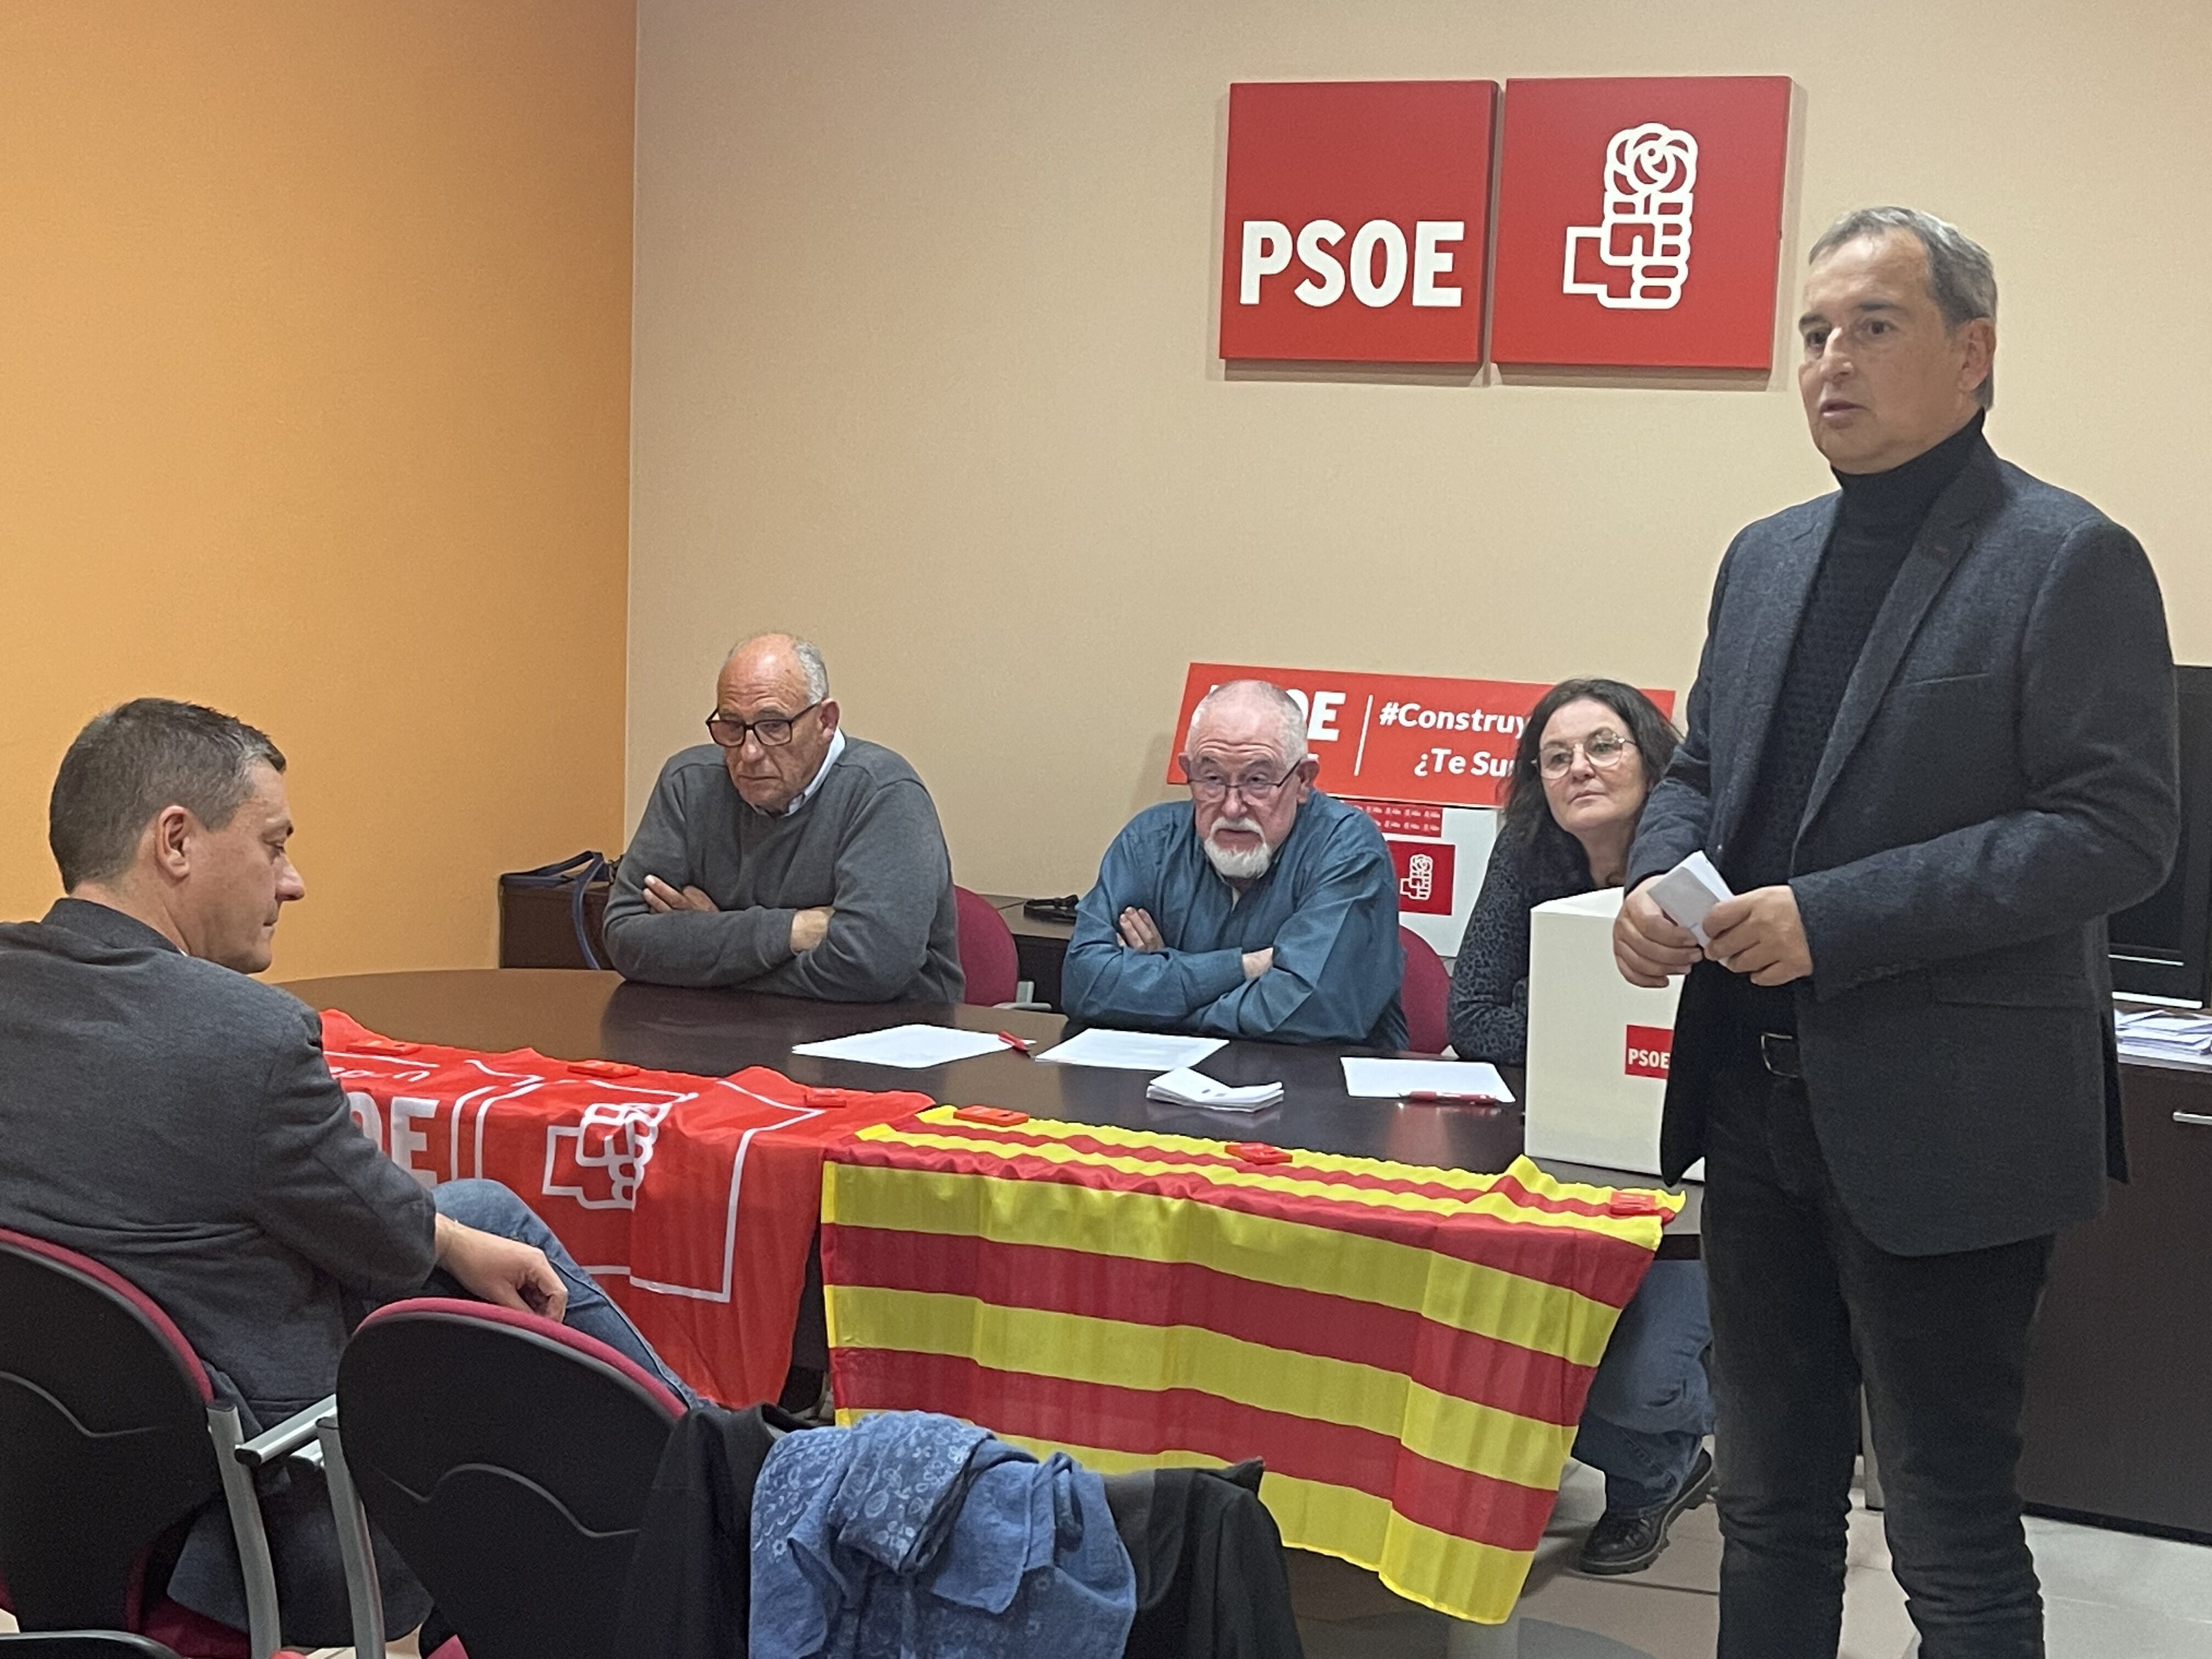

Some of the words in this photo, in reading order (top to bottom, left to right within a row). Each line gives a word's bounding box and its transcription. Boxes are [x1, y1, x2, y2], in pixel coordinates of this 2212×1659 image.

[1239, 219, 1465, 307] PSOE
[1414, 748, 1466, 776] ¿Te
[1470, 751, 1515, 777] Su
[1628, 1048, 1671, 1069] PSOE
